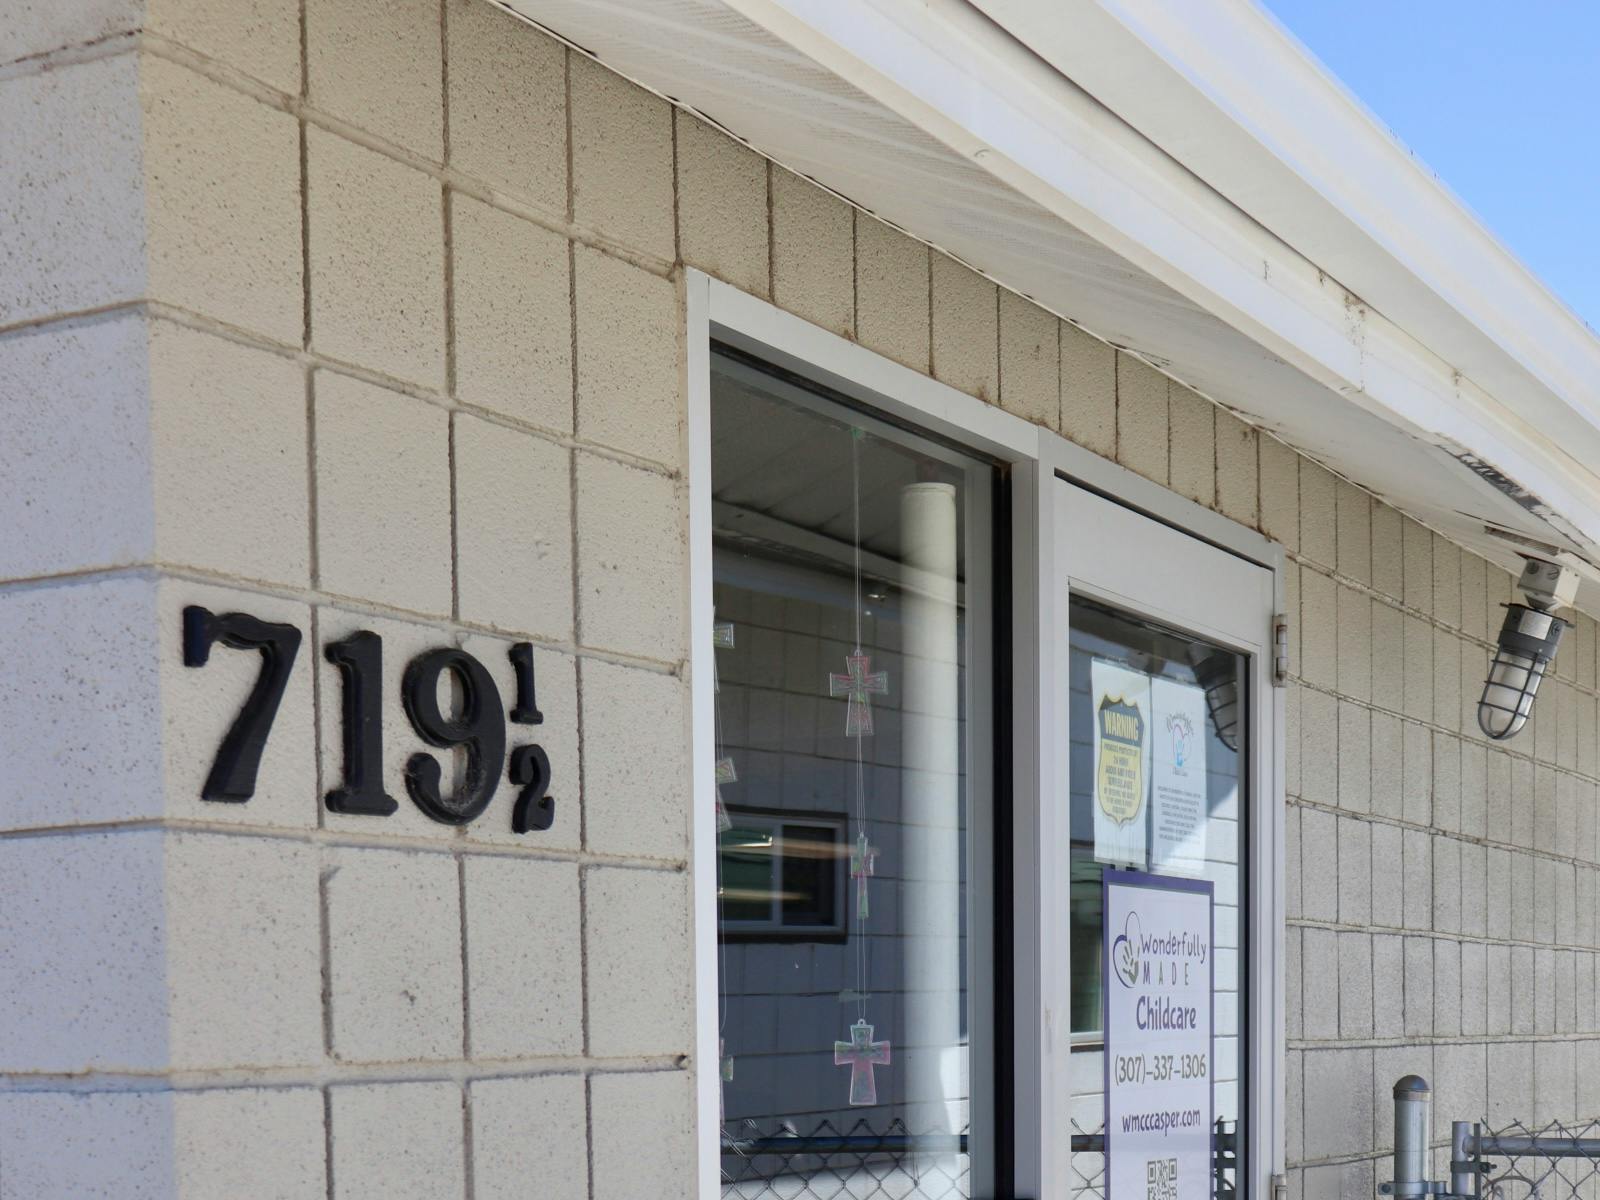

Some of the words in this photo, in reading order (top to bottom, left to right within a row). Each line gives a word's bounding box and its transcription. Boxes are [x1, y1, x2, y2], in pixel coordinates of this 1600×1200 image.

[183, 605, 506, 826] 719
[1104, 709, 1139, 741] WARNING
[1140, 932, 1206, 964] Wonderfully
[1136, 995, 1197, 1030] Childcare
[1114, 1053, 1206, 1086] (307)-337-1306
[1122, 1108, 1201, 1137] wmcccasper.com
